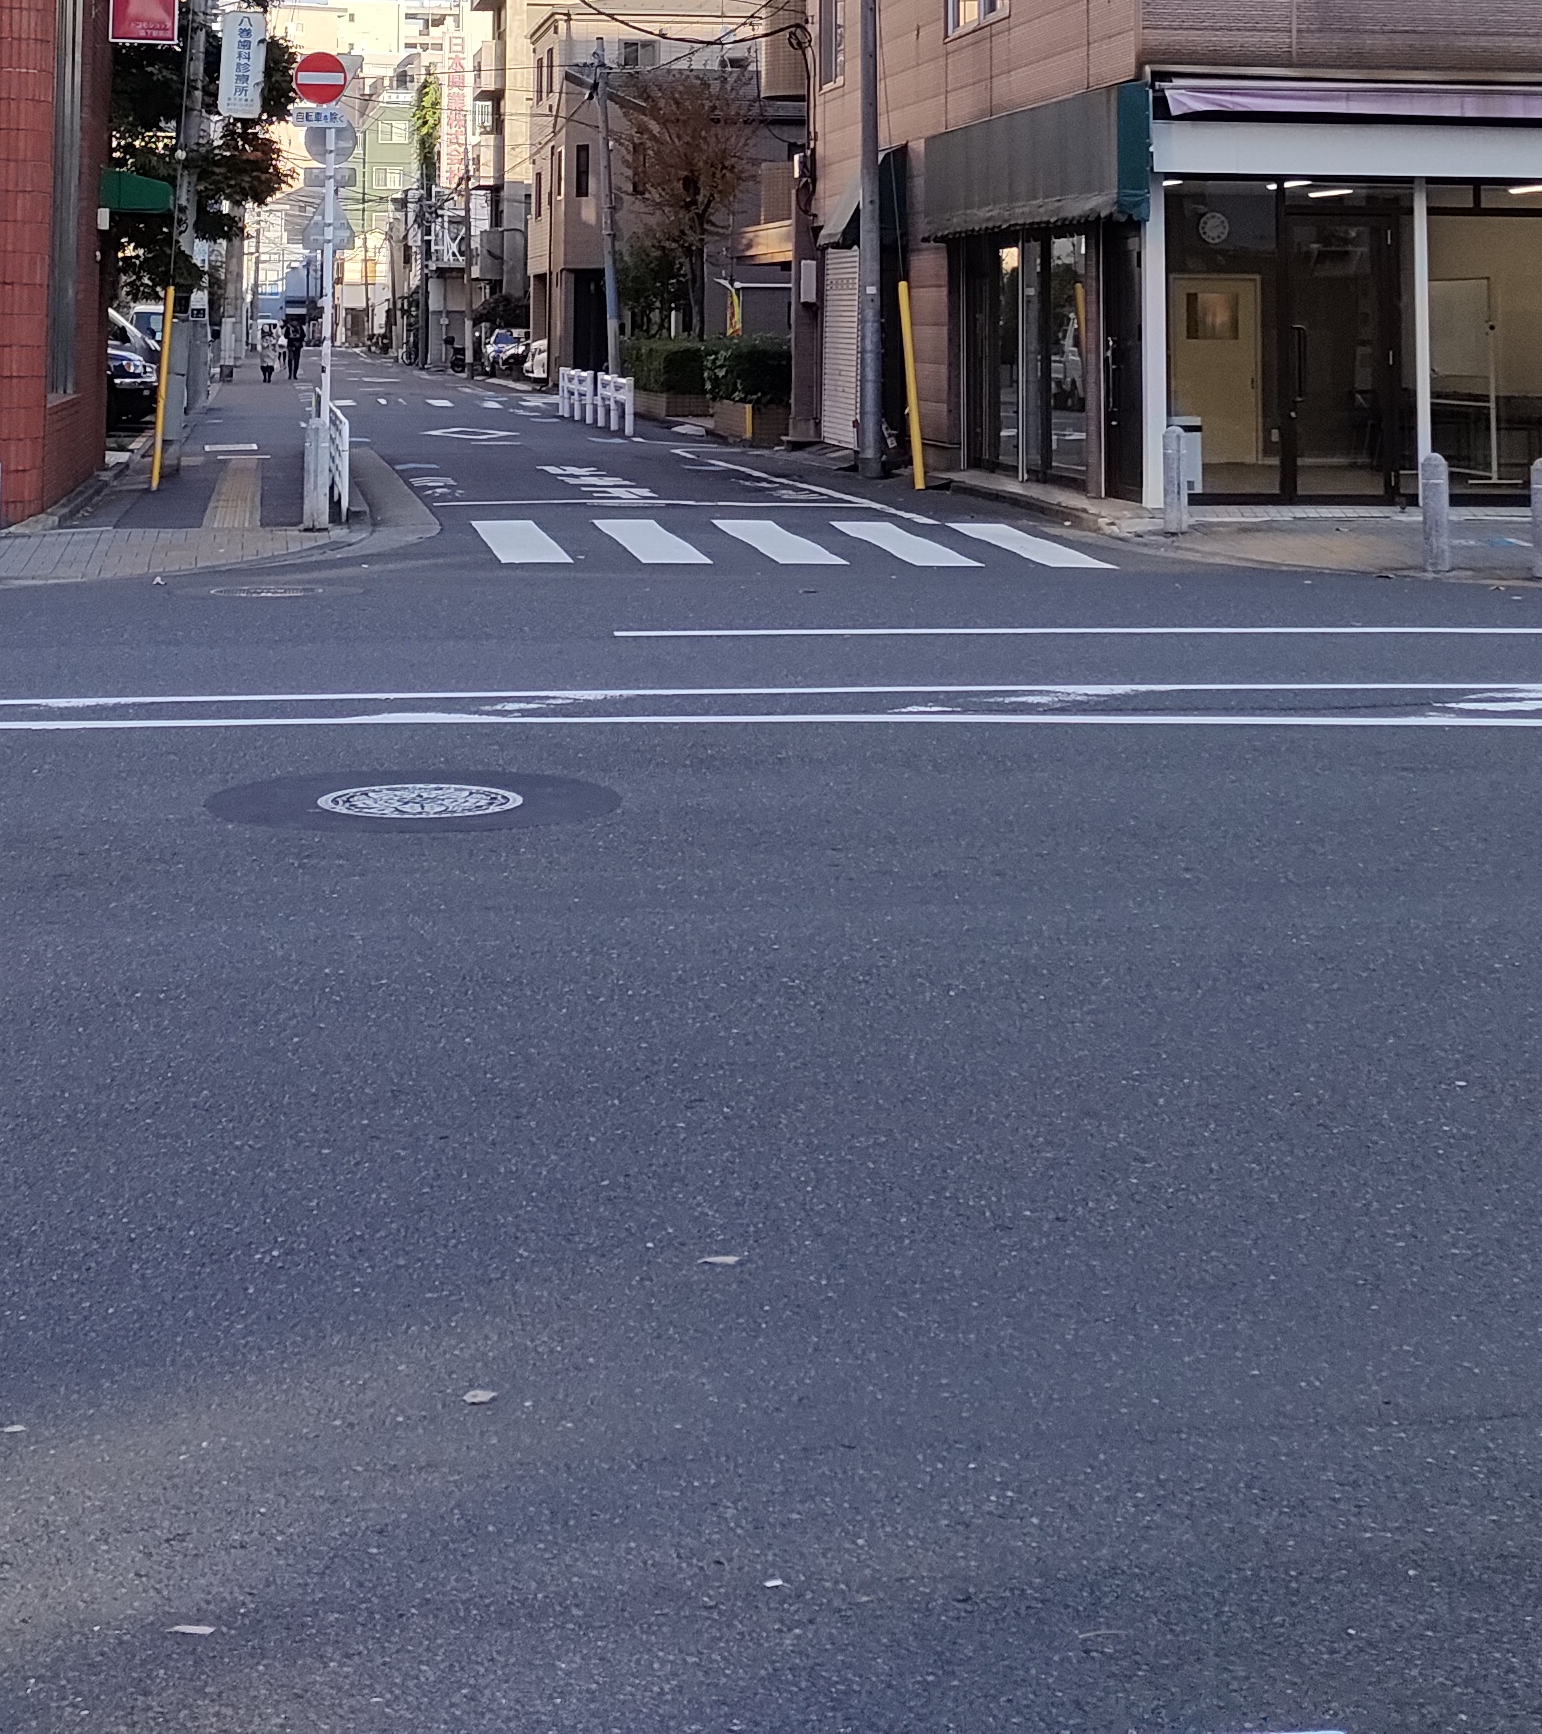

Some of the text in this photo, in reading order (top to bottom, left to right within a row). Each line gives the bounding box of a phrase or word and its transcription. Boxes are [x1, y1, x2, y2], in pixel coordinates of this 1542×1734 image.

[296, 111, 345, 124] 自転車を除く
